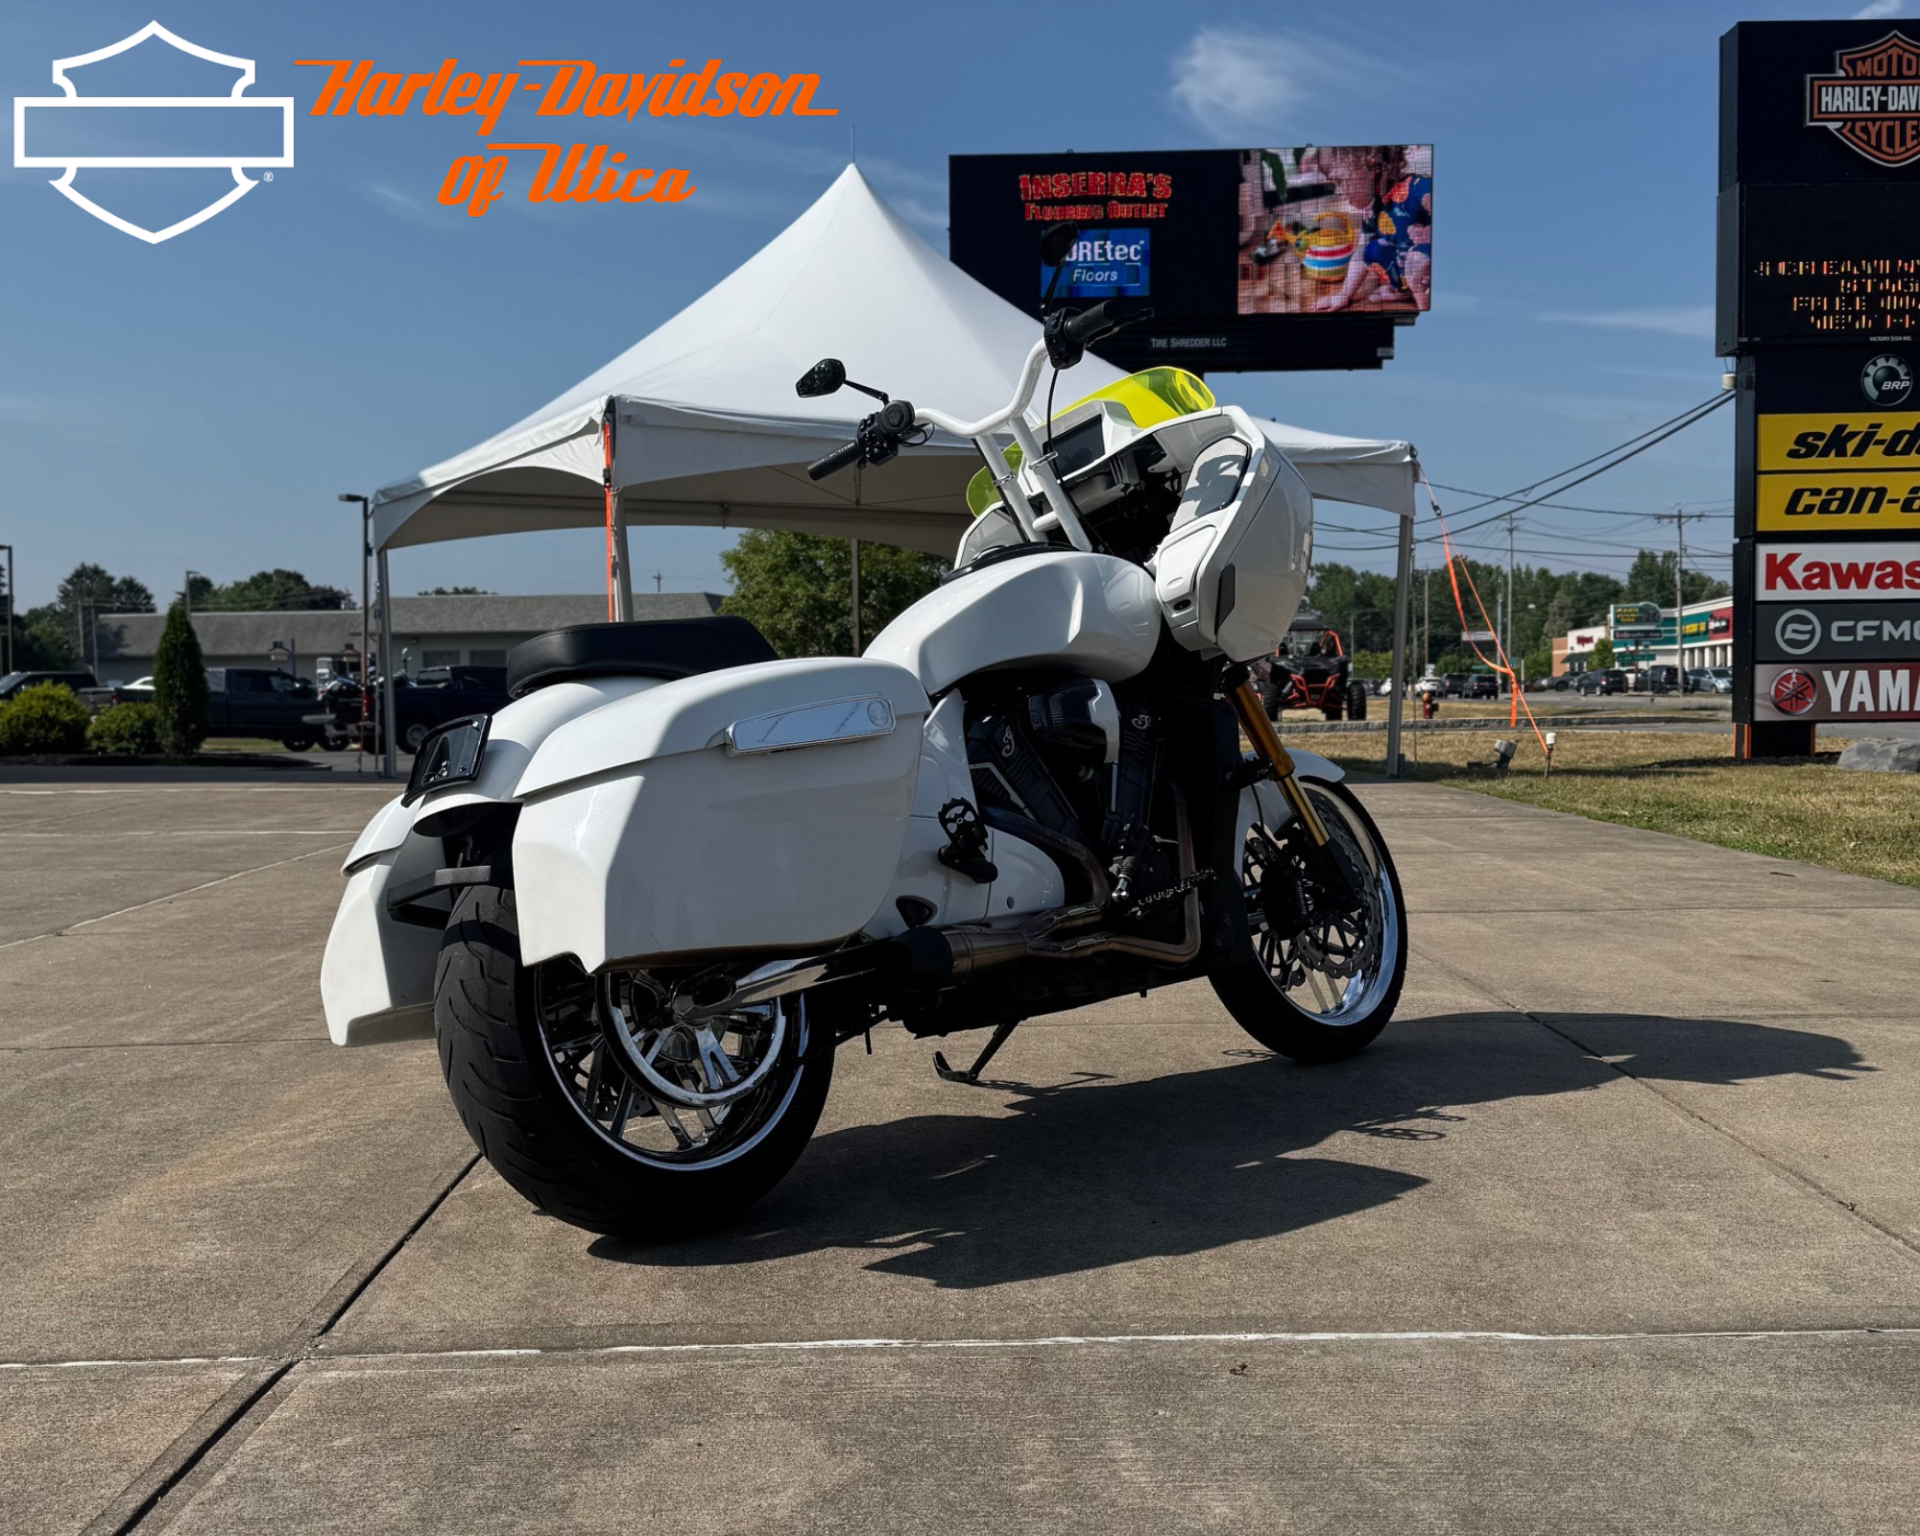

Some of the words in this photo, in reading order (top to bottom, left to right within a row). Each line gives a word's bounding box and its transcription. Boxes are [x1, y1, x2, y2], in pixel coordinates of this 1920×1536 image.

[1856, 46, 1920, 77] MOTO
[1854, 120, 1920, 155] CYCLE
[1019, 172, 1172, 200] INSERRA'S
[1106, 201, 1168, 219] OUTLET
[1072, 268, 1118, 282] Floors
[1881, 381, 1910, 390] BRP
[1786, 422, 1920, 460] ski-d
[1830, 619, 1920, 642] CFM
[1822, 669, 1920, 713] YAM
